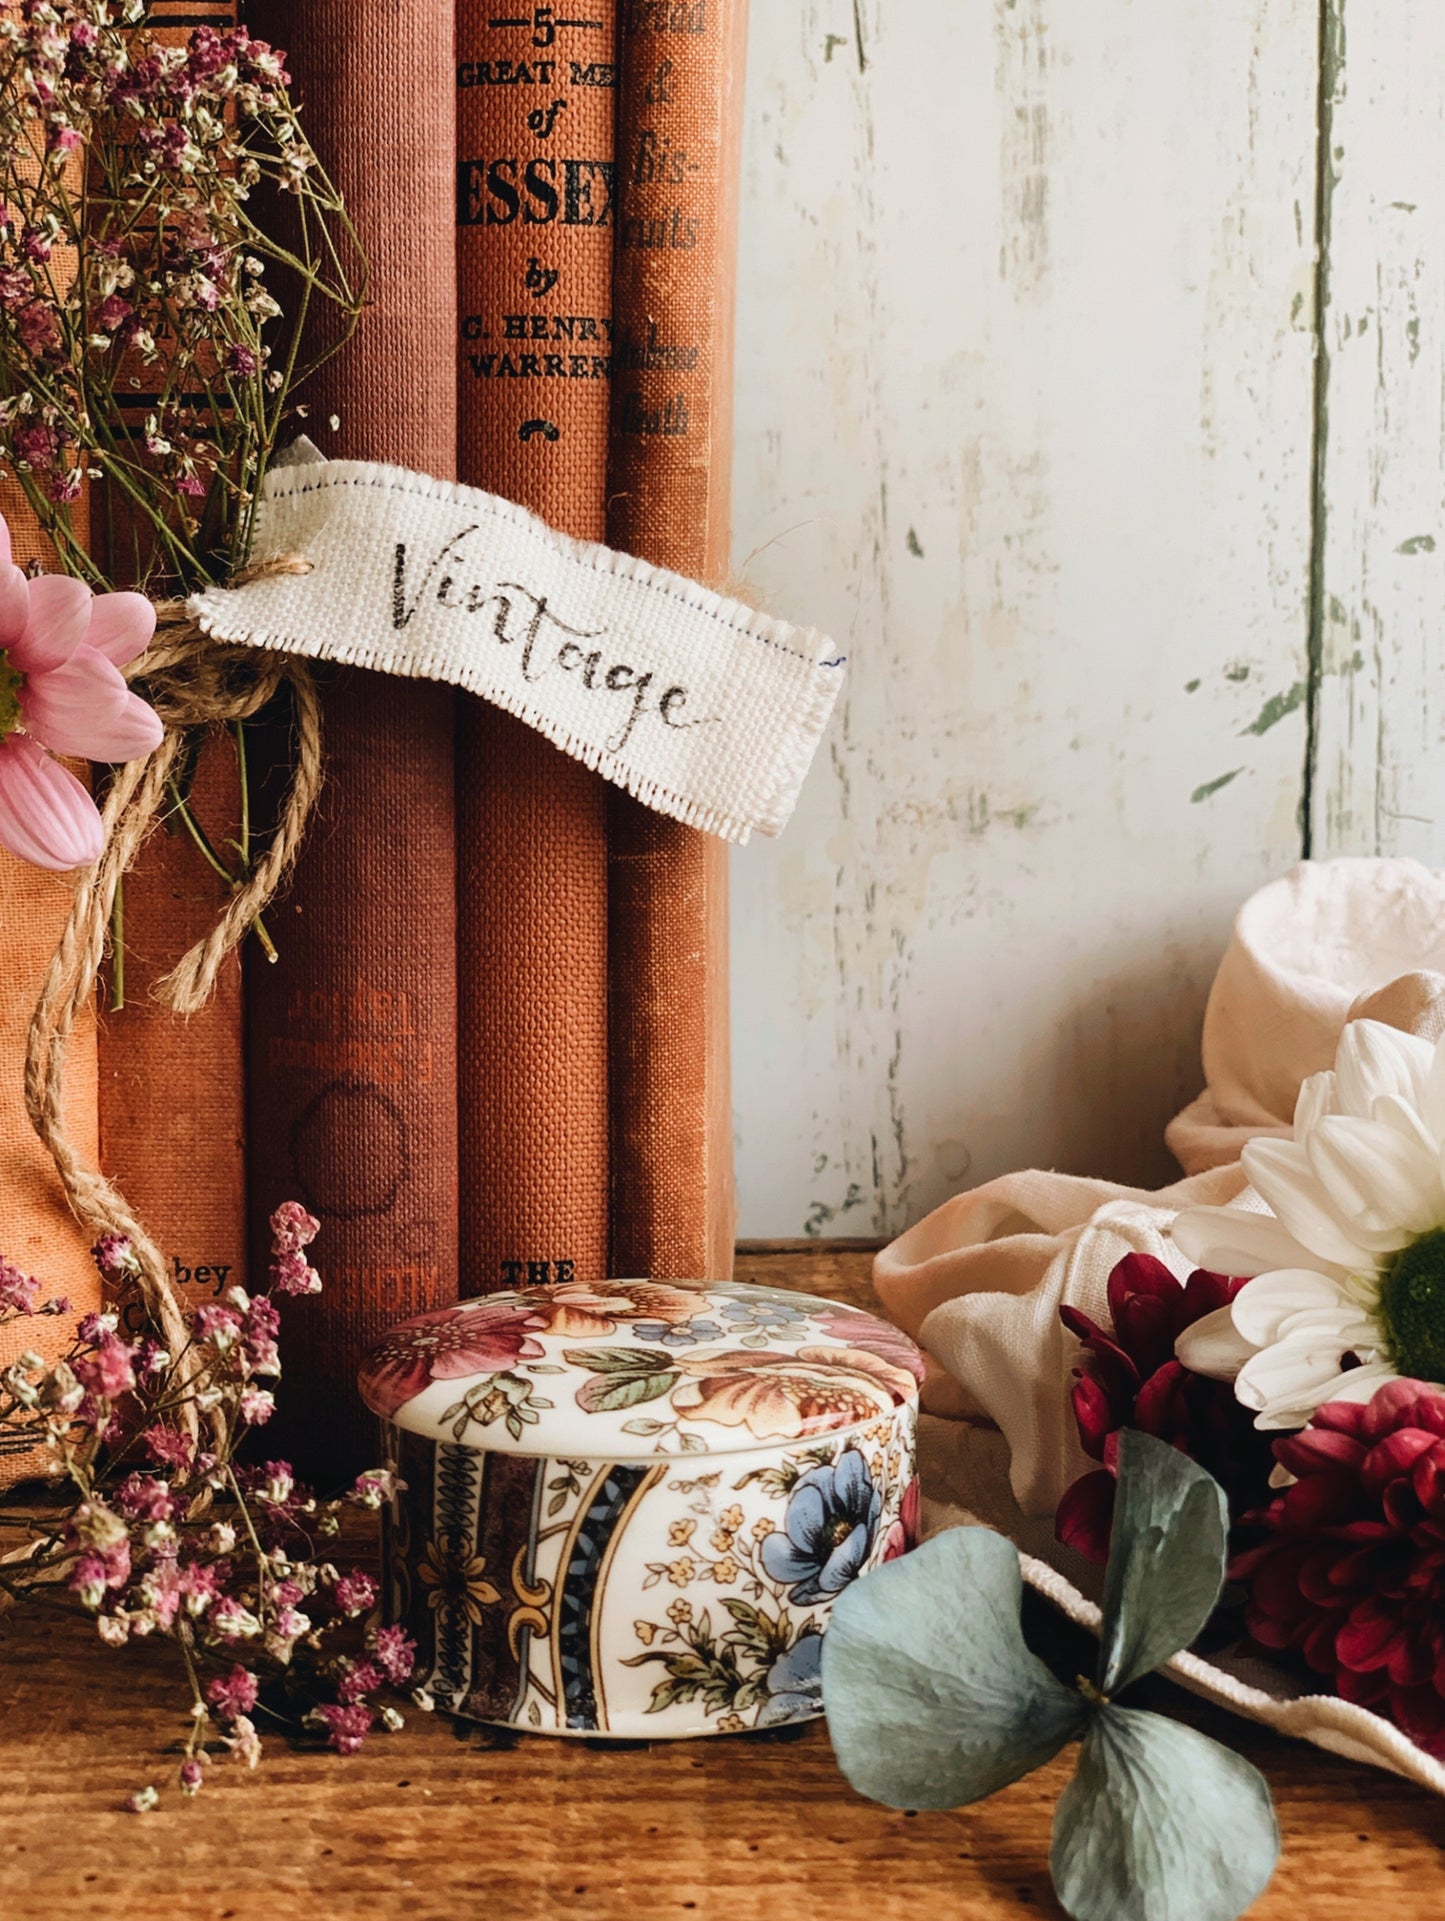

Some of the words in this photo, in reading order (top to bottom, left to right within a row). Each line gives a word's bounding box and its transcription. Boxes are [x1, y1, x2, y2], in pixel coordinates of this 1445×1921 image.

[531, 8, 556, 47] 5
[457, 61, 556, 87] GREAT
[570, 62, 619, 88] ME
[527, 98, 567, 138] of
[524, 257, 559, 297] by
[461, 315, 490, 340] C.
[468, 354, 613, 379] WARREN
[392, 525, 722, 753] Vintage
[168, 1256, 232, 1296] bey
[500, 1259, 575, 1284] THE
